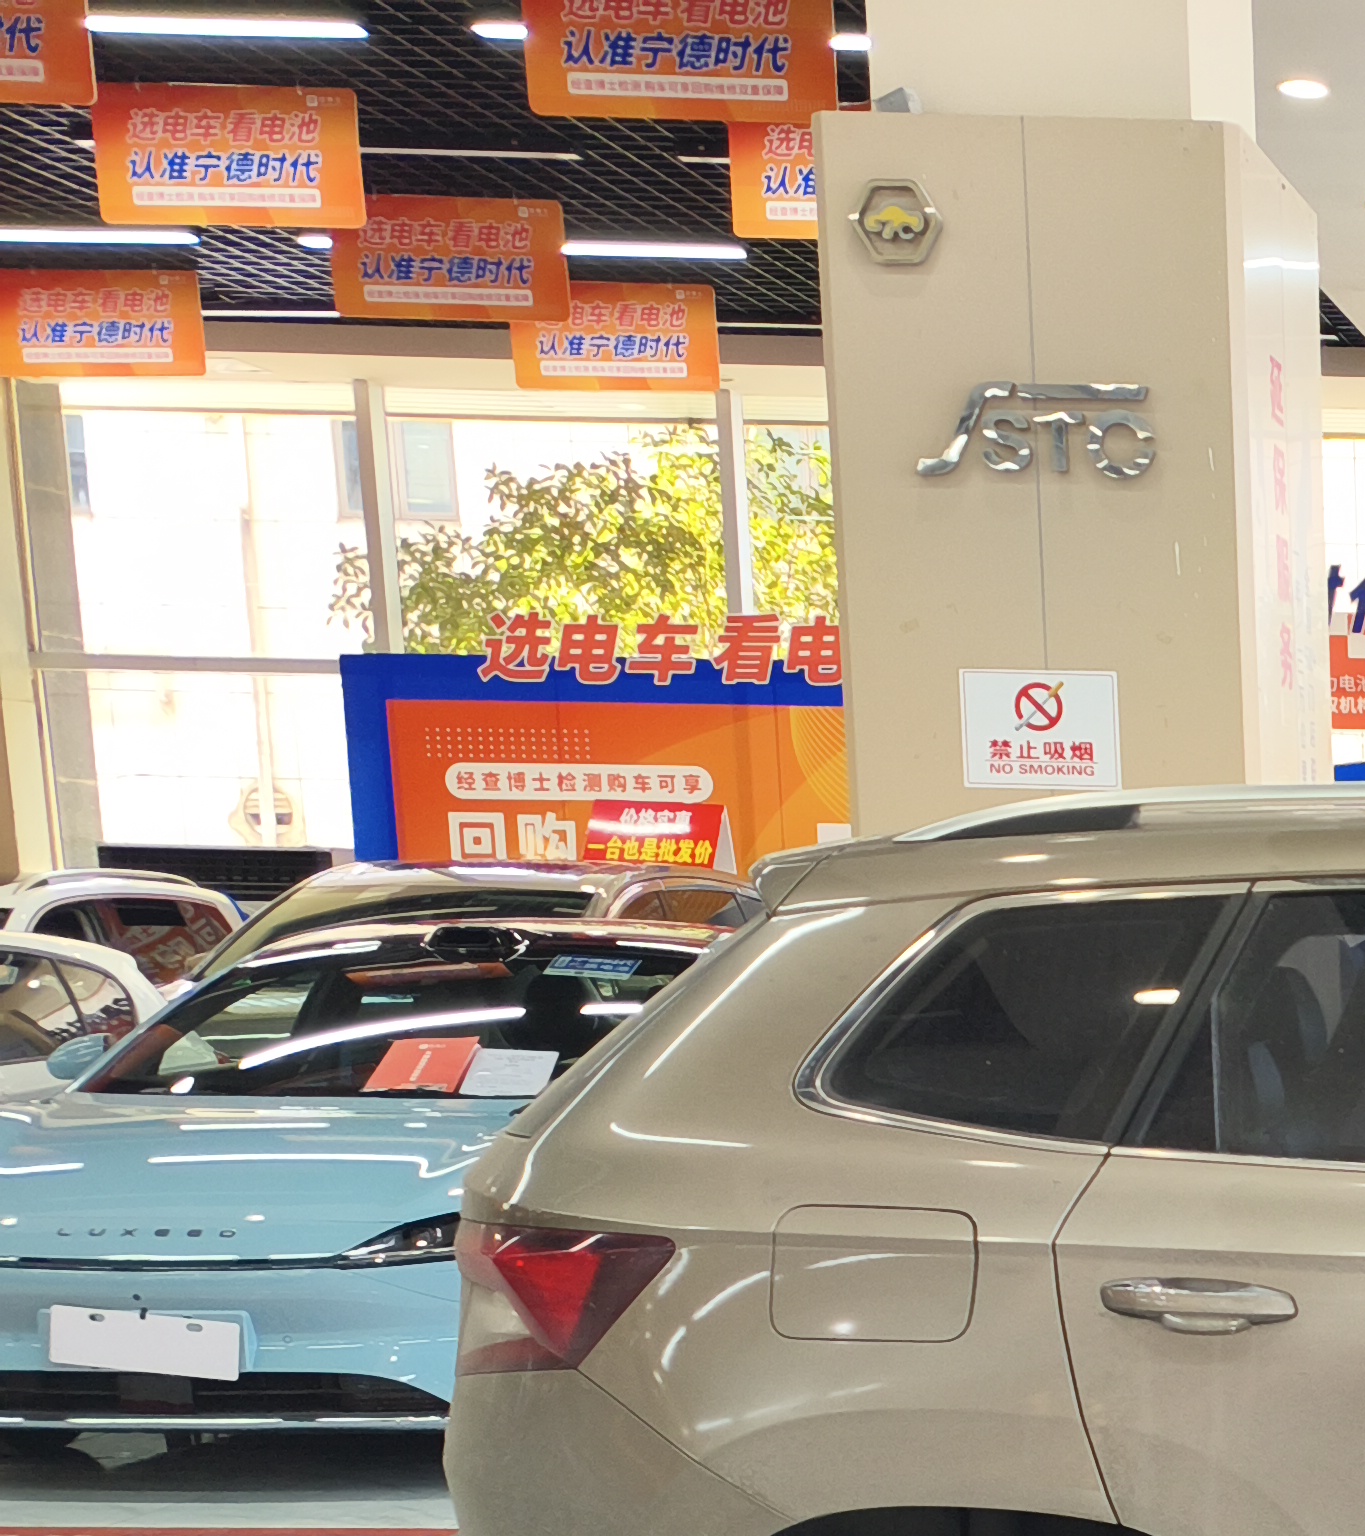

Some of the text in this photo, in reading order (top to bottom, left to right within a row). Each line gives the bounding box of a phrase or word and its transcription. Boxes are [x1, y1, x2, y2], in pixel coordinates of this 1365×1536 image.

[562, 29, 791, 74] 认准宁德时代
[128, 109, 319, 145] 选电车 看电池
[128, 150, 321, 184] 认准宁德时代
[359, 217, 532, 250] 选电车 看电池
[359, 254, 533, 286] 认准宁德时代
[19, 288, 171, 317] 选电车 看电池
[614, 302, 686, 329] 看电池
[19, 320, 172, 345] 认准宁德时代
[536, 333, 688, 359] 认准宁德时代
[479, 611, 698, 684] 选电车
[988, 739, 1094, 762] 禁止吸烟
[455, 770, 703, 794] 经查博士检测购车可享
[989, 763, 1095, 776] NO SMOKING
[619, 808, 692, 833] 价格实惠
[587, 836, 713, 865] 一台也是批发价
